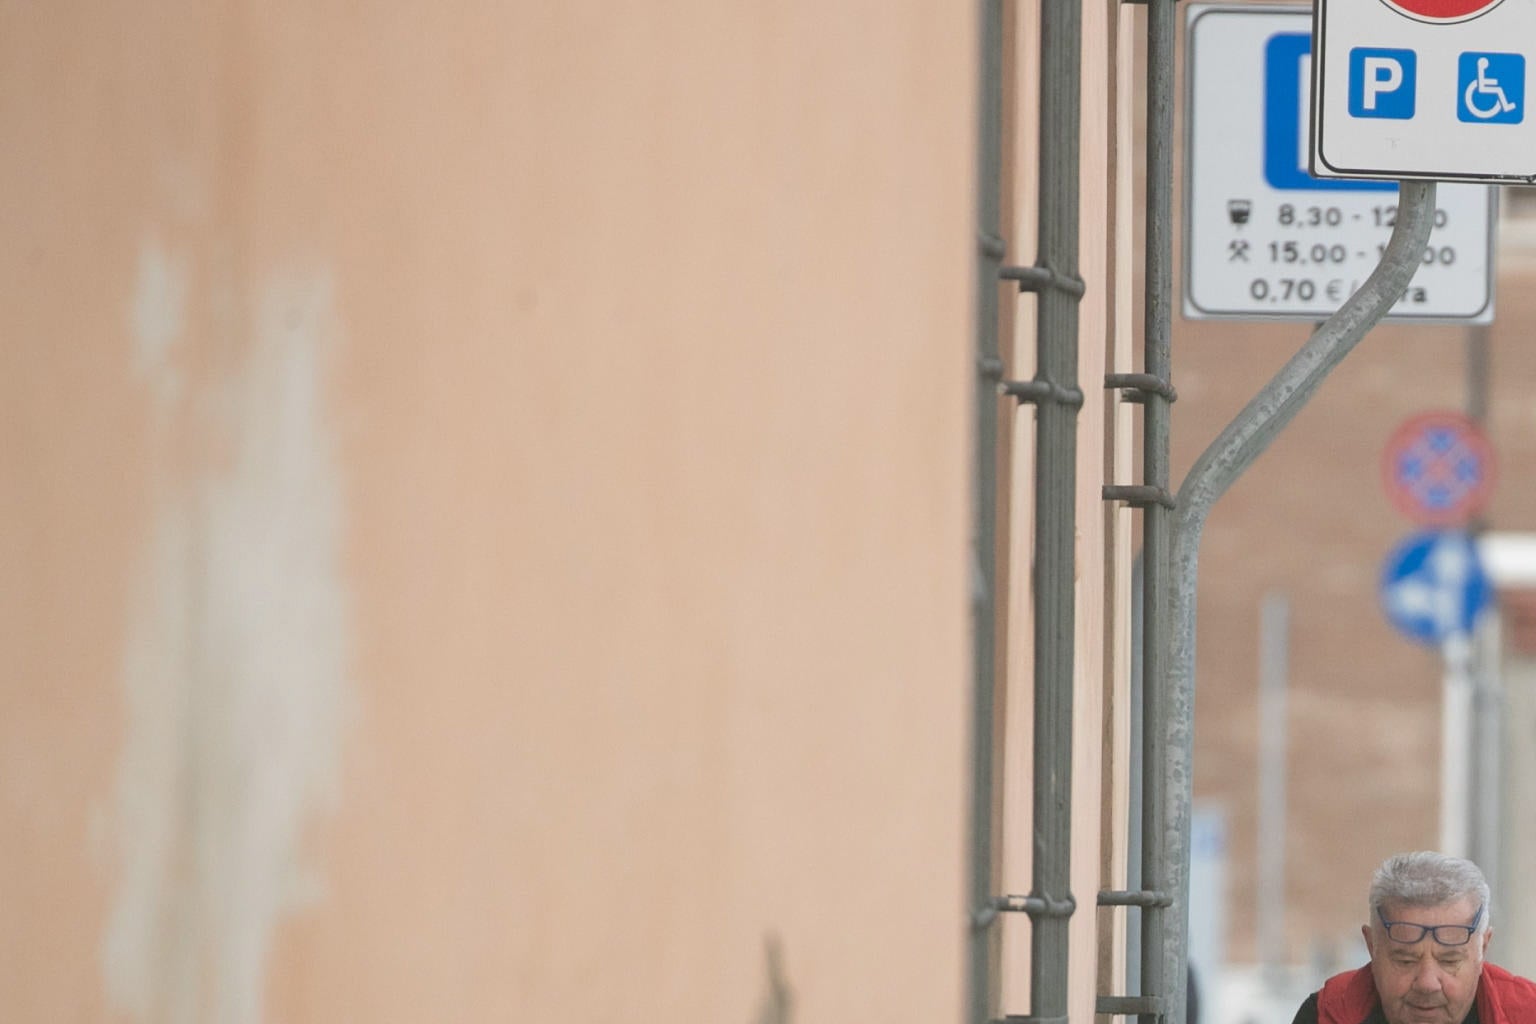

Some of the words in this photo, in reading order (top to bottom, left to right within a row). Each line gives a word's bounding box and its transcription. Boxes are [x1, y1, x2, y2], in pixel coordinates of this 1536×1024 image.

[1363, 57, 1403, 110] P
[1267, 241, 1346, 265] 15.00
[1250, 278, 1315, 303] 0.70
[1326, 279, 1344, 302] €
